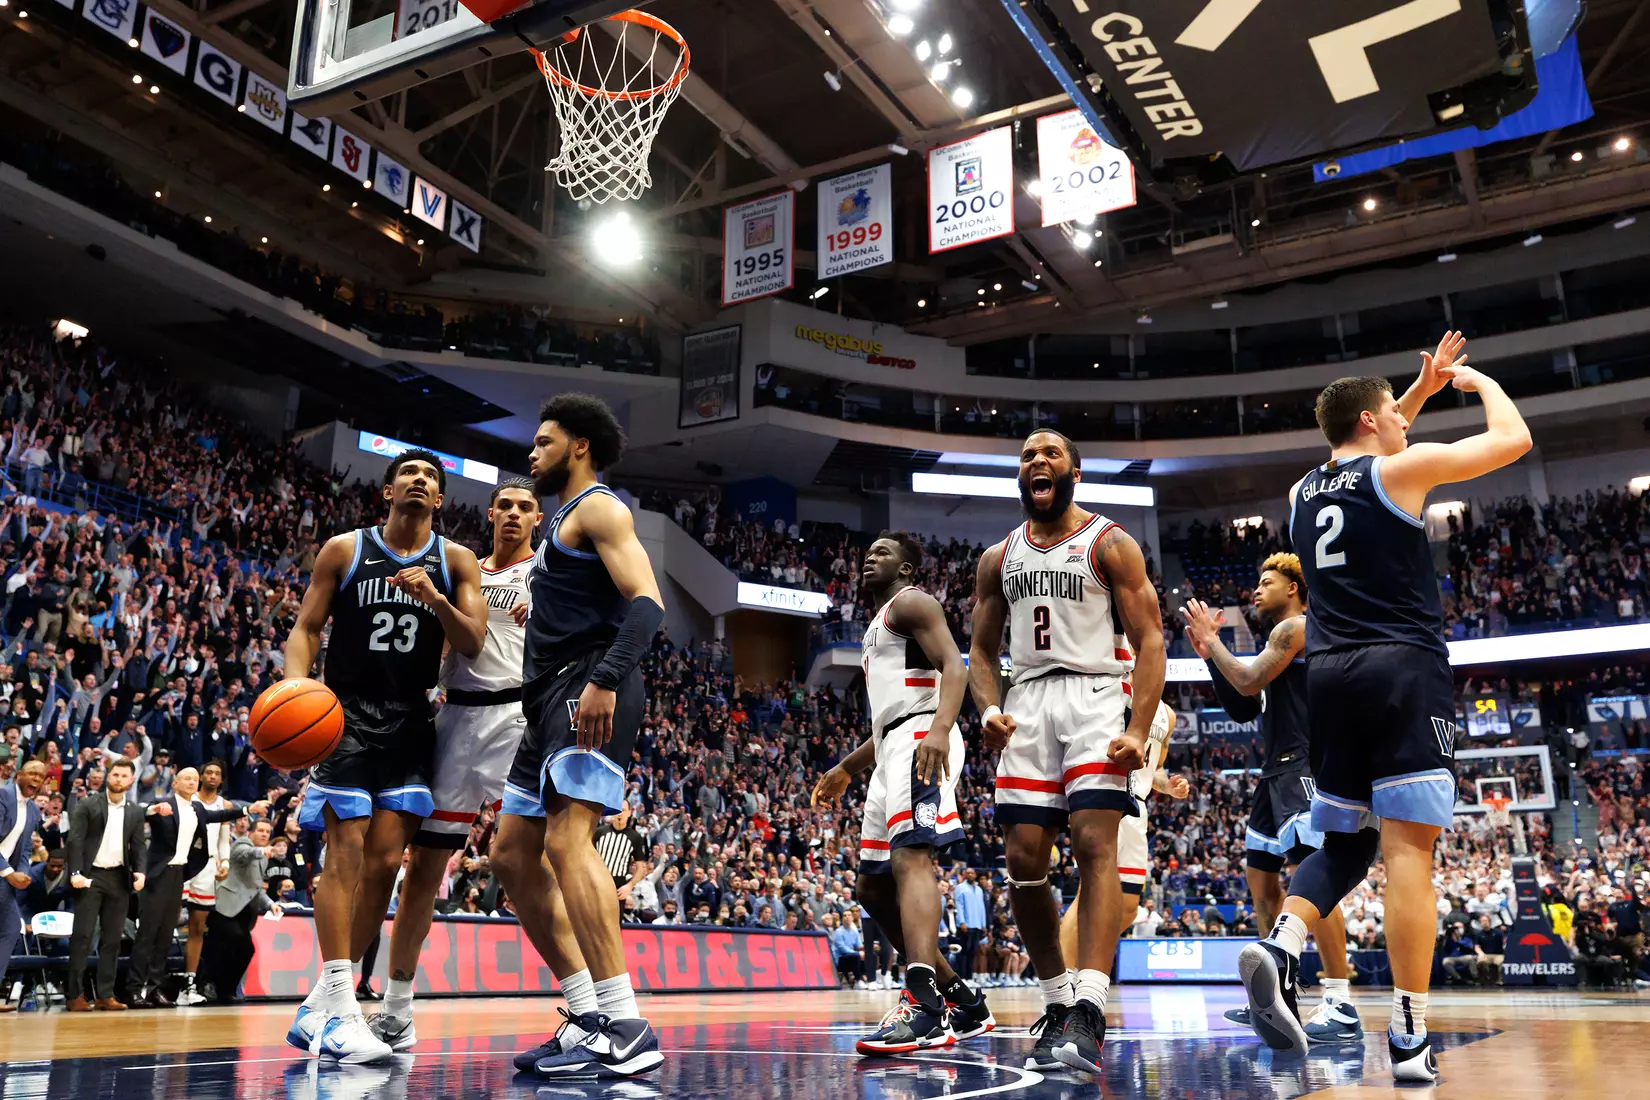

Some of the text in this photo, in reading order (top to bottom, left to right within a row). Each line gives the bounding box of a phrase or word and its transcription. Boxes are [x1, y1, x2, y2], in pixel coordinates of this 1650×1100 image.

[200, 52, 234, 96] G
[1091, 12, 1203, 141] CENTER
[1051, 160, 1124, 194] 2002
[420, 184, 442, 218] V
[935, 190, 1005, 224] 2000
[454, 208, 476, 244] X
[826, 222, 883, 252] 1999
[940, 223, 1003, 247] CHAMPIONS
[943, 214, 997, 235] NATIONAL
[733, 248, 785, 277] 1995
[825, 254, 885, 276] CHAMPIONS
[829, 244, 880, 264] NATIONAL
[731, 280, 786, 301] CHAMPIONS
[735, 270, 783, 289] NATIONAL
[796, 324, 884, 355] megabus
[749, 501, 768, 514] 220
[1315, 504, 1347, 569] 2
[357, 577, 437, 617] VILLA
[761, 588, 806, 609] xfinity
[1003, 570, 1086, 605] CONNECTICUT
[369, 611, 420, 653] 23
[1033, 605, 1052, 651] 2
[1201, 719, 1259, 735] UCONN
[1430, 716, 1456, 758] V
[706, 932, 746, 988] &
[747, 935, 838, 987] SON
[1501, 962, 1577, 976] TRAVELERS
